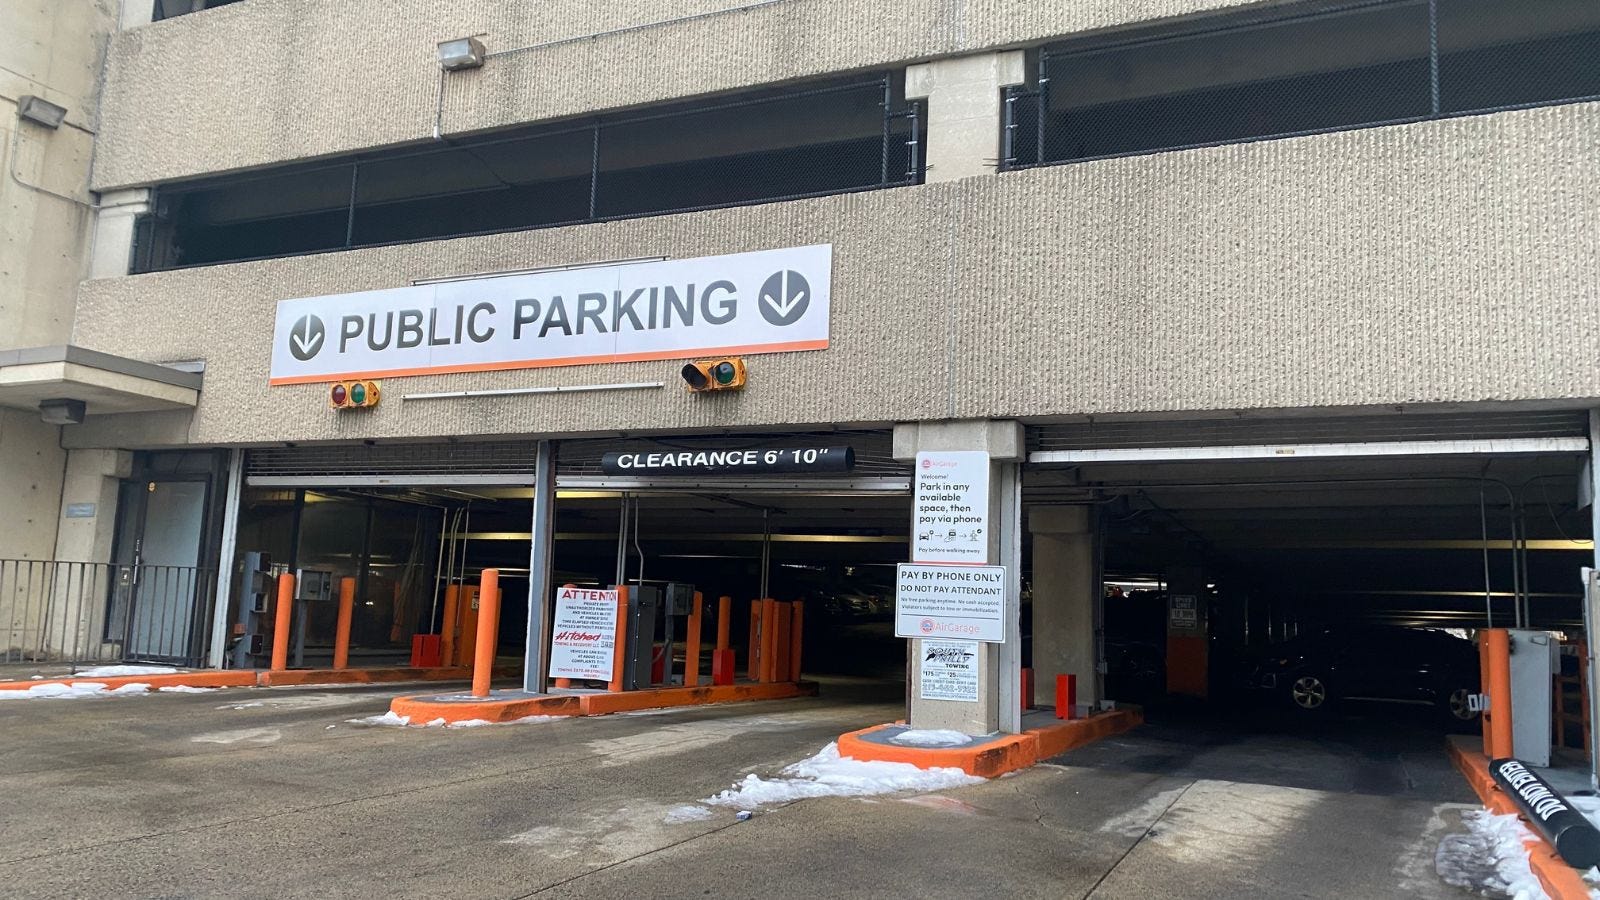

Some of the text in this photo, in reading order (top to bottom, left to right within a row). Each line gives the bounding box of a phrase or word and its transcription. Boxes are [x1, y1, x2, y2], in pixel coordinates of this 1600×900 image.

[338, 279, 739, 354] PUBLIC PARKING
[616, 449, 758, 470] CLEARANCE
[920, 482, 941, 490] Park
[952, 484, 970, 492] any
[920, 493, 961, 502] available
[920, 504, 971, 514] space, then
[919, 515, 982, 524] pay via phone
[901, 571, 1002, 582] PAY BY PHONE ONLY
[900, 584, 1002, 595] DO NOT PAY ATTENDANT
[935, 622, 981, 634] AirGarage
[555, 631, 601, 641] Hitched
[1499, 761, 1569, 821] DO NOT ENTER
